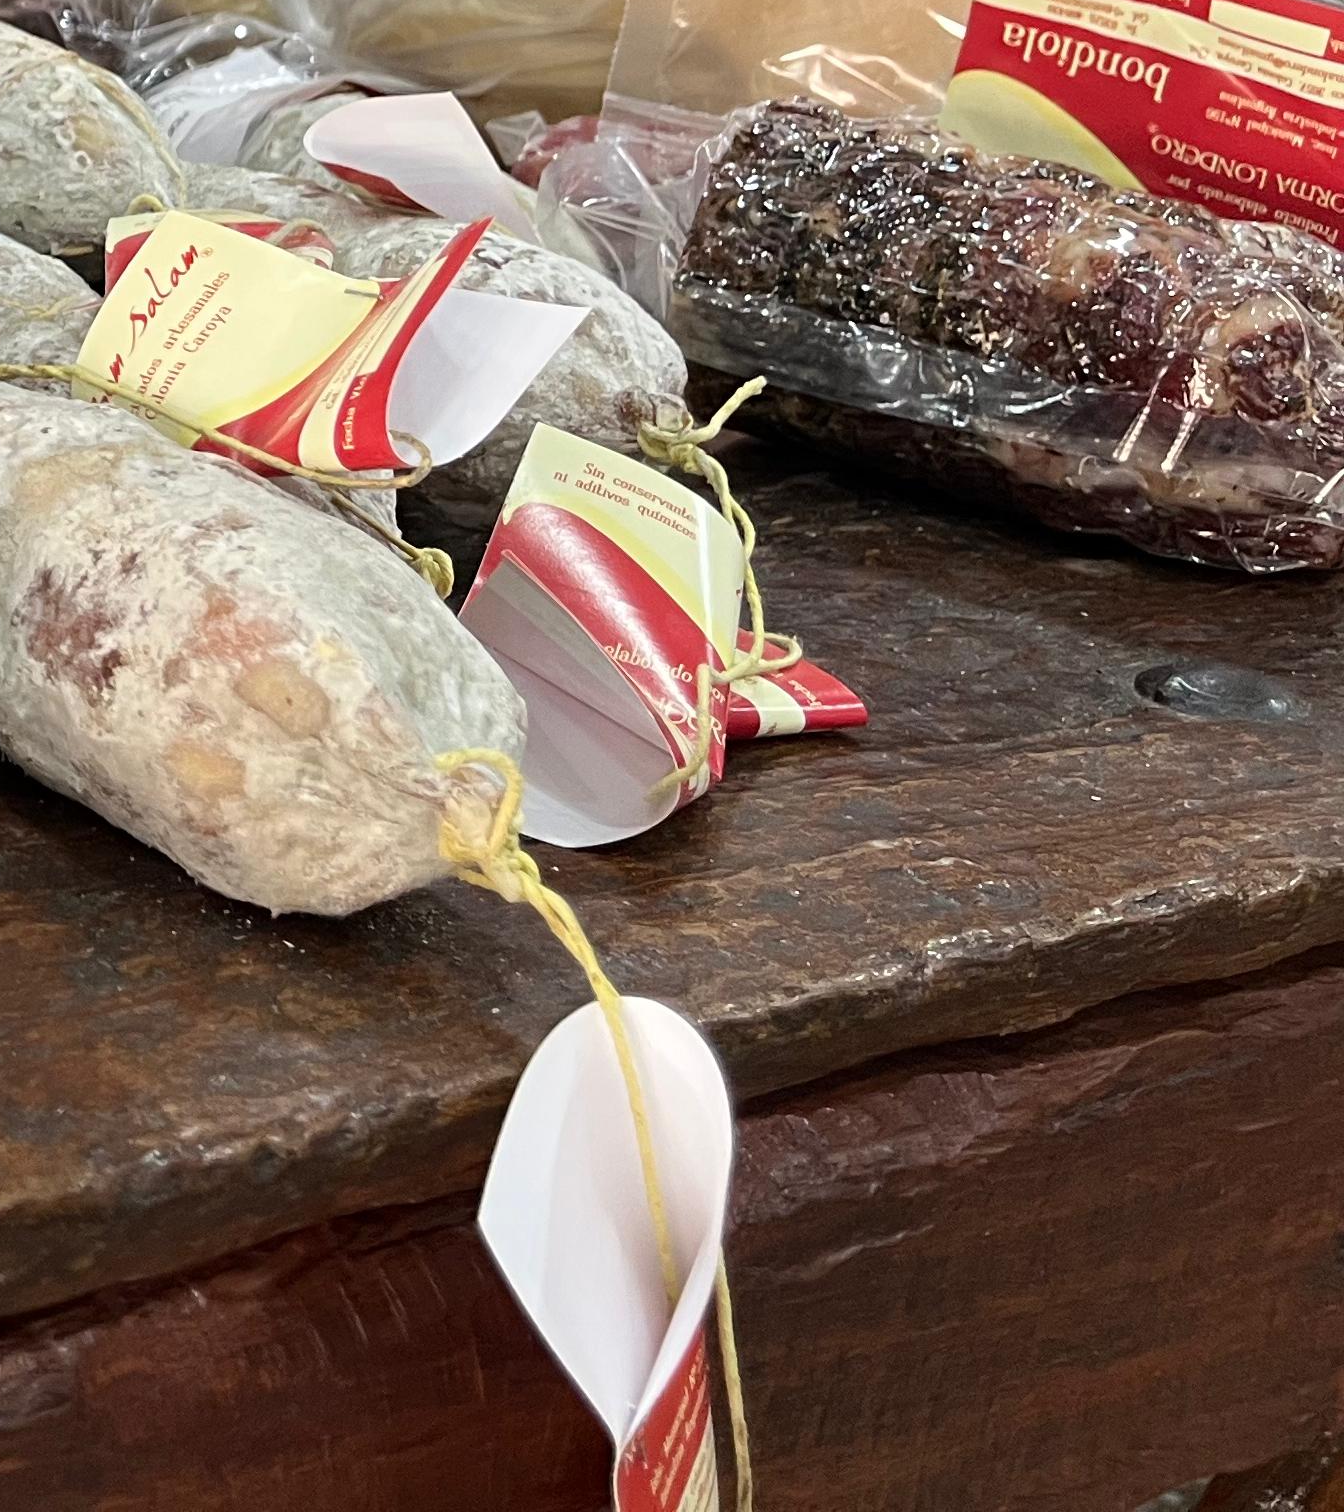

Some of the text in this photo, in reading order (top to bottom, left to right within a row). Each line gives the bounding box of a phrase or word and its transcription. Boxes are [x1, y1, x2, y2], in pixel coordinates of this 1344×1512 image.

[1002, 22, 1170, 103] bondiola
[1151, 134, 1268, 189] LONDERO
[163, 271, 230, 350] artesanales
[145, 305, 232, 420] Clonia Caroya
[342, 407, 356, 451] Fecha
[553, 470, 569, 484] ni
[575, 479, 630, 507] aditivos
[583, 462, 606, 480] Sin
